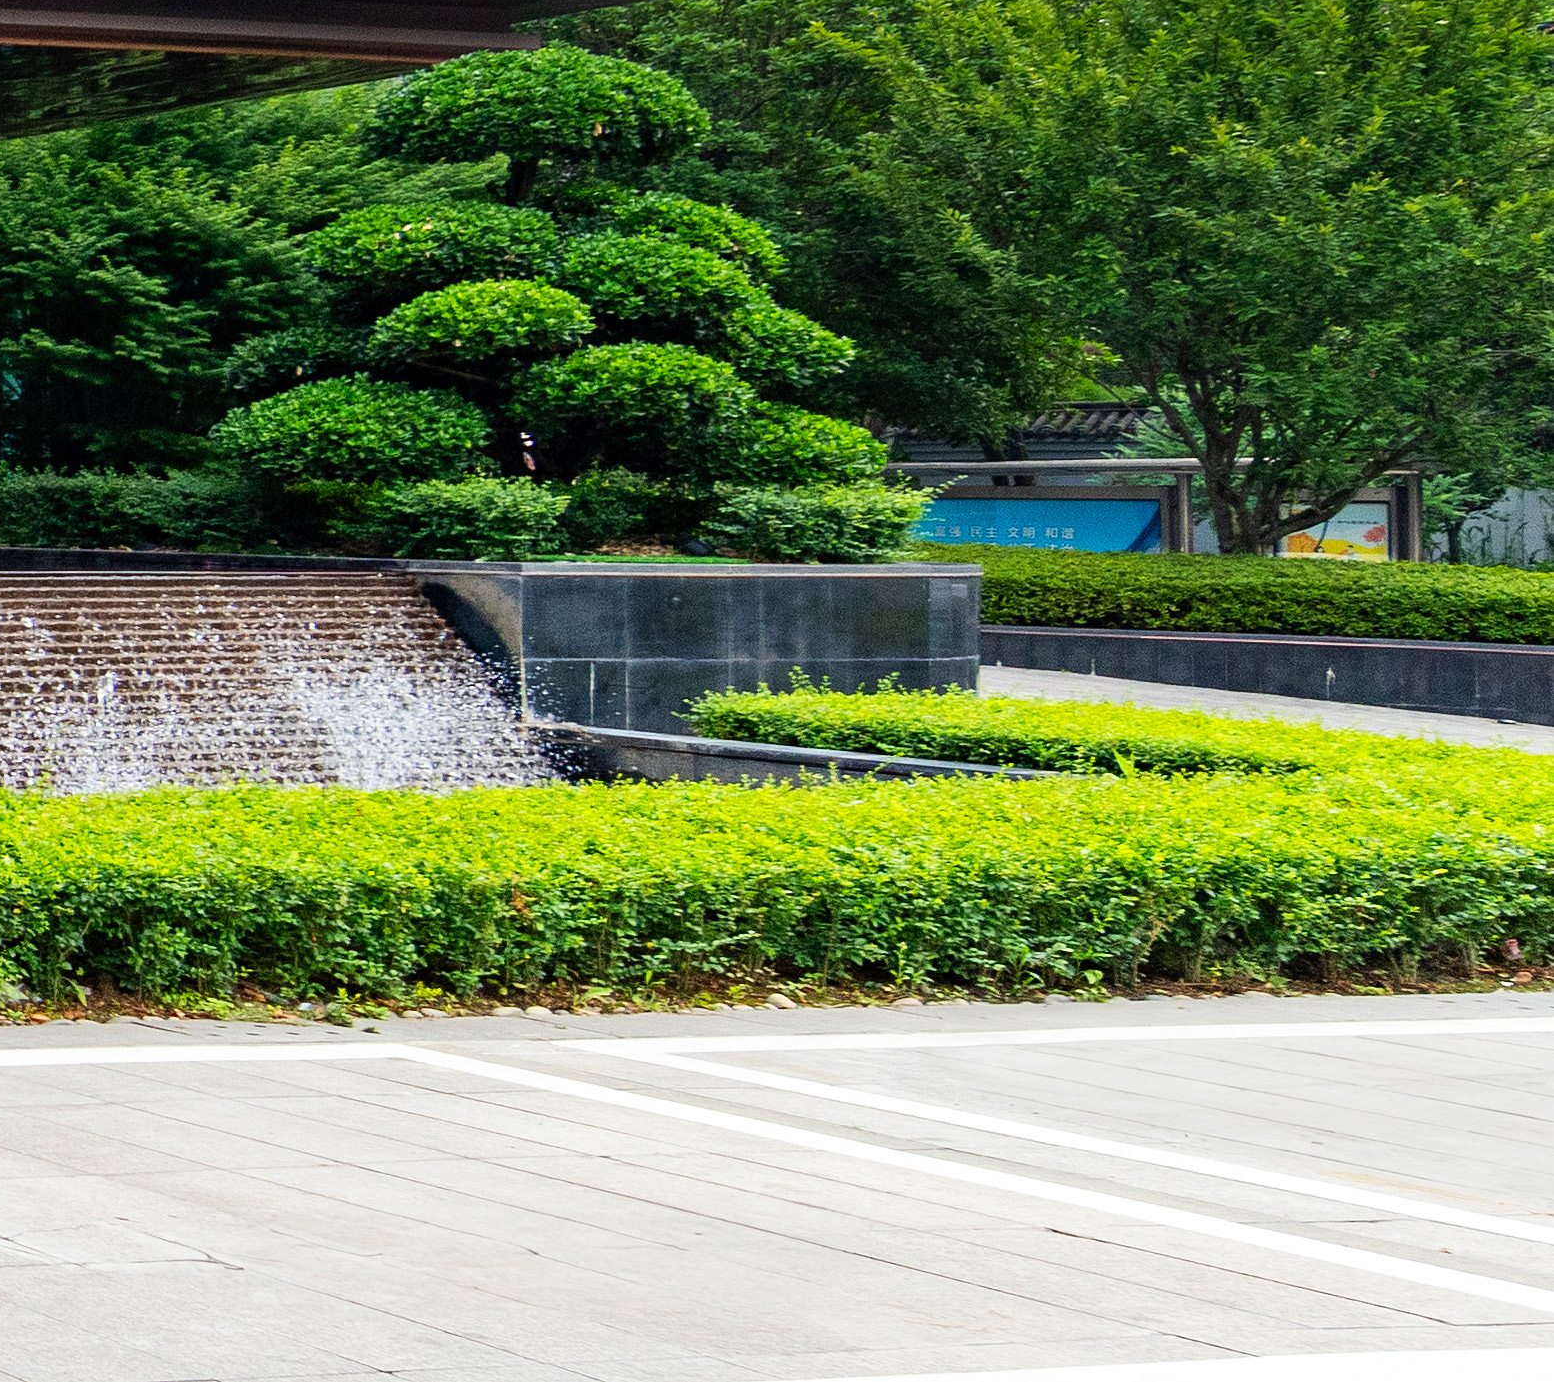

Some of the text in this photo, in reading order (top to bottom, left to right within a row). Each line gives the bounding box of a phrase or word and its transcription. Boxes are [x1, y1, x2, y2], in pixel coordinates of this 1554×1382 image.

[970, 526, 997, 539] 民主
[1008, 526, 1036, 539] 文明
[1045, 527, 1075, 540] 和谐
